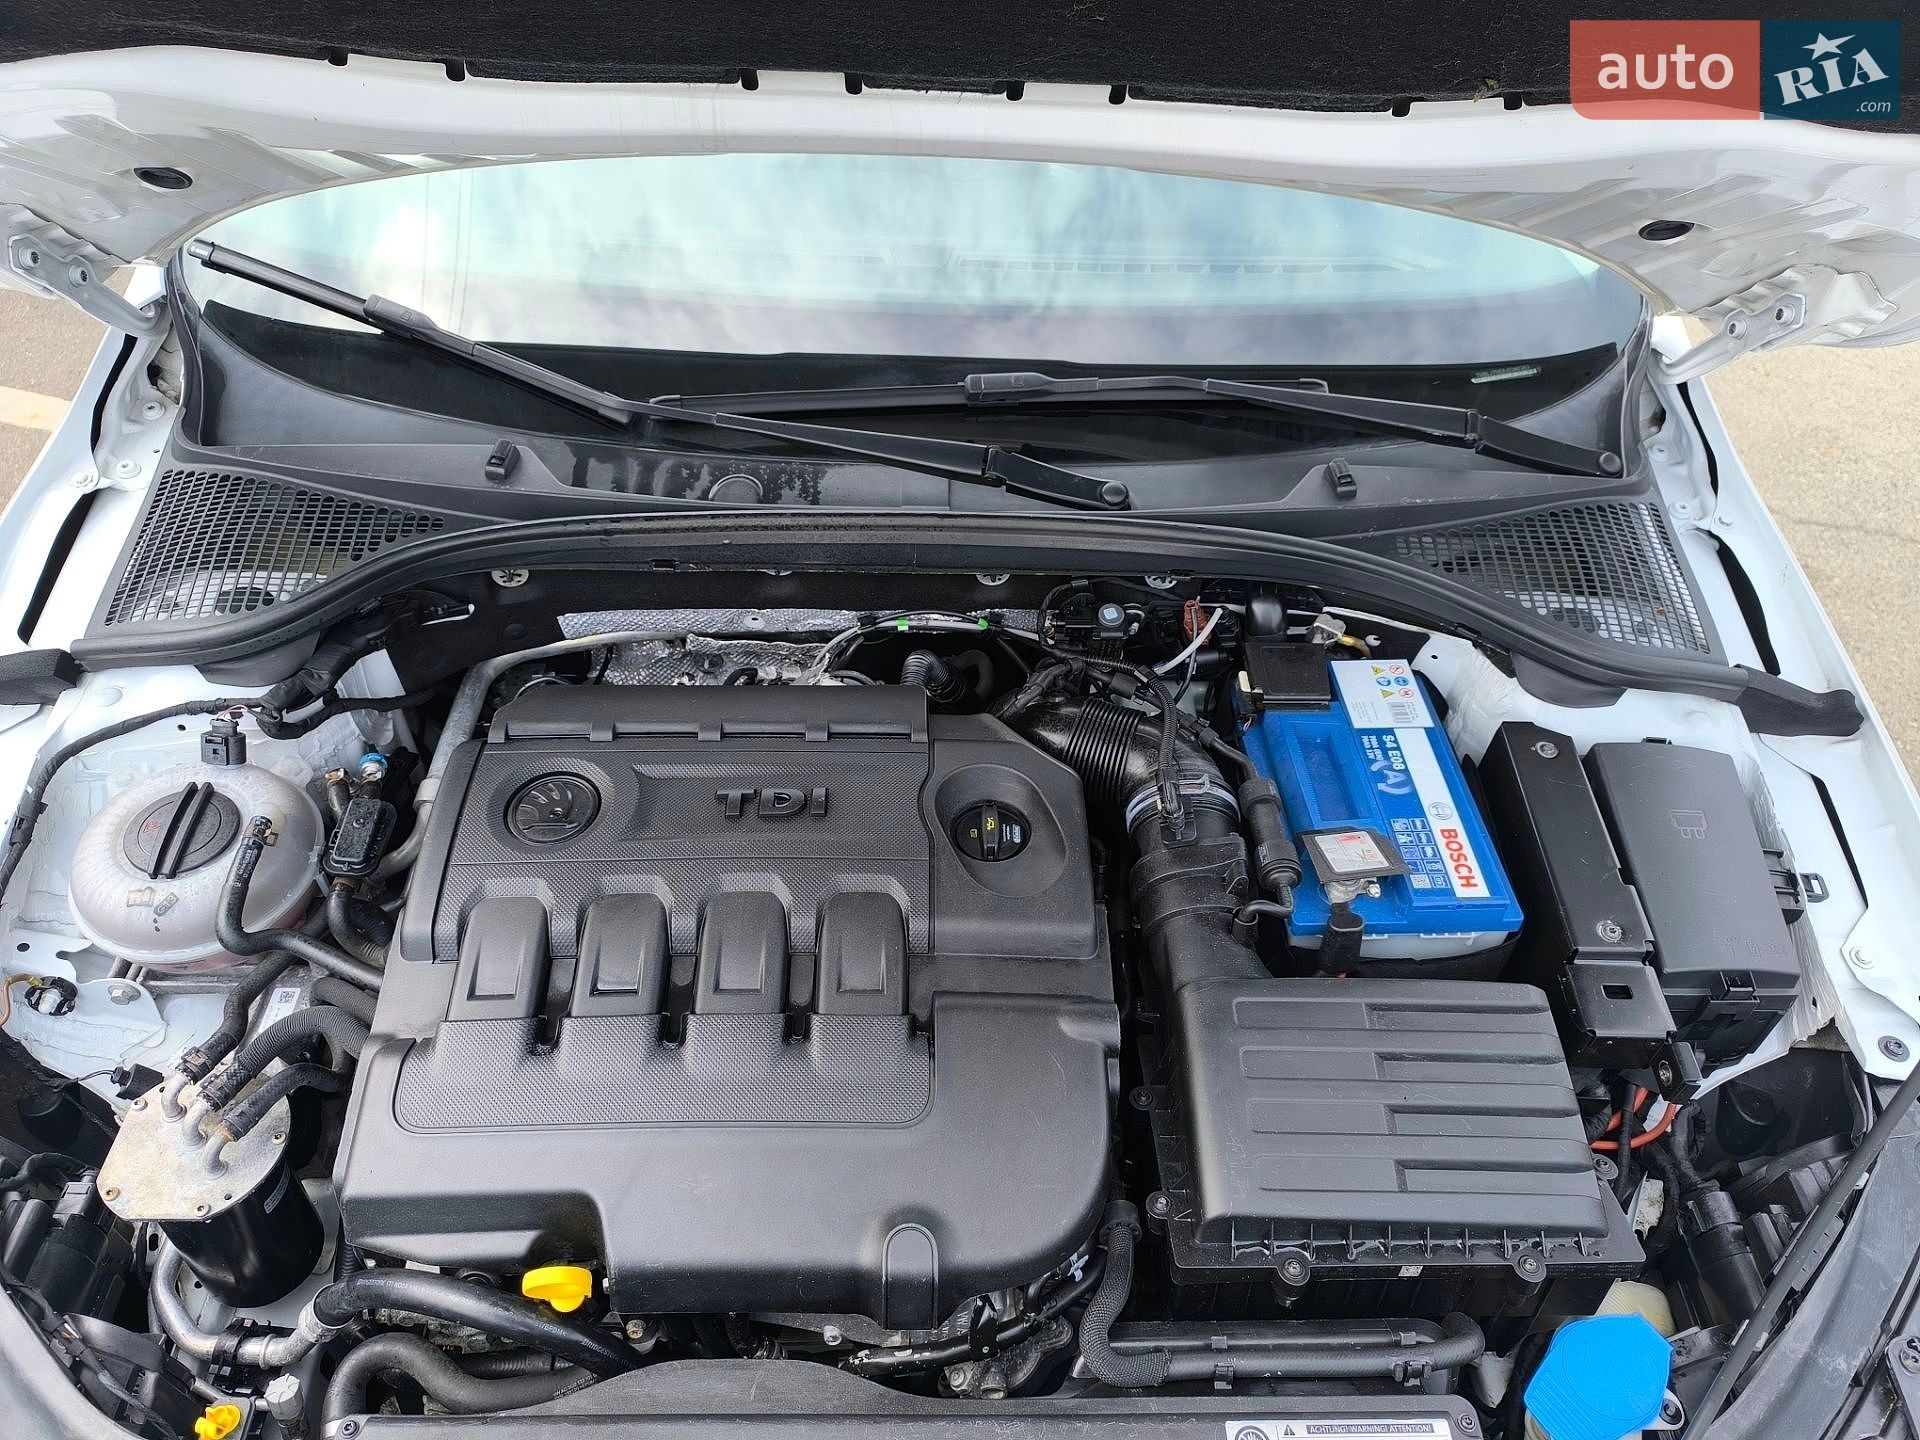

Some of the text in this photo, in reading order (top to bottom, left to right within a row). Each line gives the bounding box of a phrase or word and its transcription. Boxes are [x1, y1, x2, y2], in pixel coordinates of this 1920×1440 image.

[1382, 735, 1406, 770] S4 E08
[715, 787, 828, 818] TDI
[1440, 829, 1478, 887] BOSCH
[1310, 1423, 1431, 1433] ACHTUNG! WARNING! ATTENTION!
